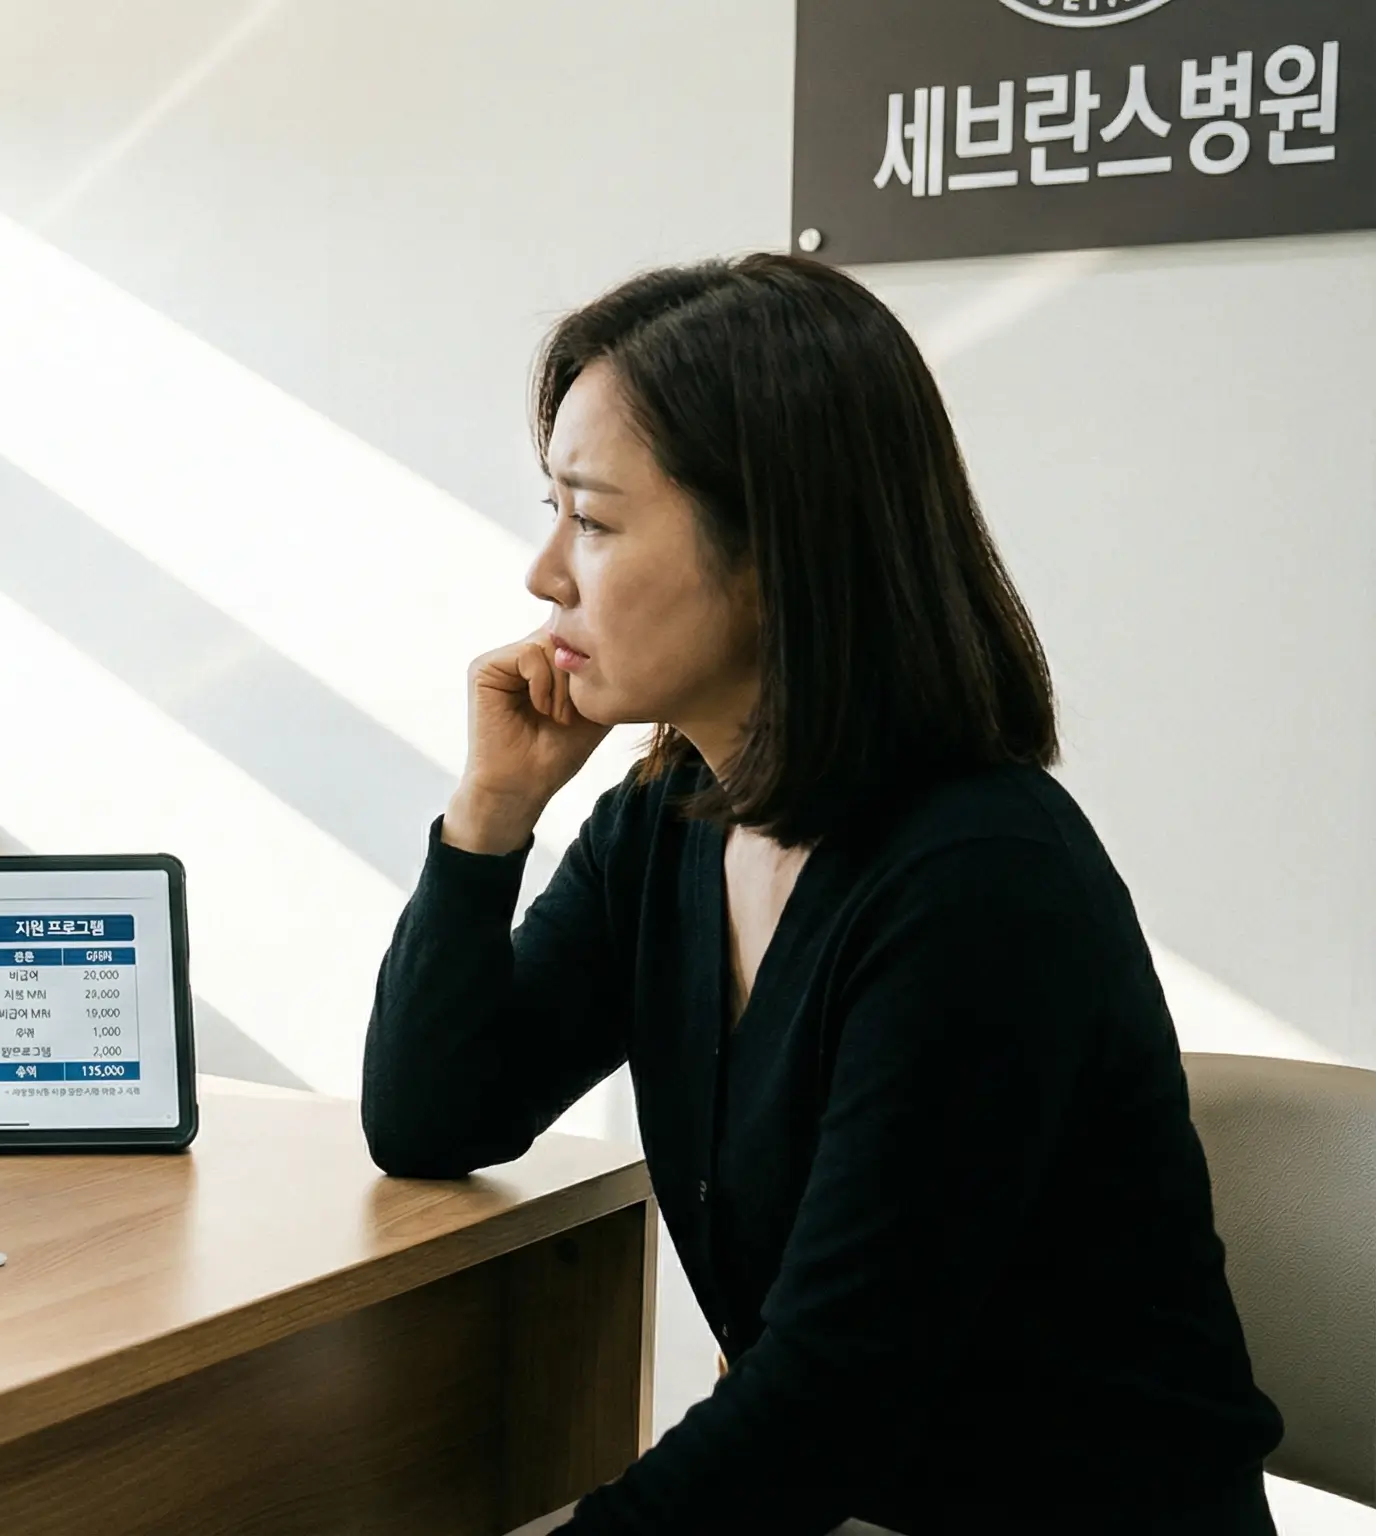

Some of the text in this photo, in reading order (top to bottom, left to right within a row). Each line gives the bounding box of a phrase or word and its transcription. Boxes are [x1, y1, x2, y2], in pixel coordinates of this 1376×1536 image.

[873, 41, 1339, 197] 세브란스병원
[15, 919, 104, 937] 지원 프로그램
[93, 1026, 121, 1038] 1,000
